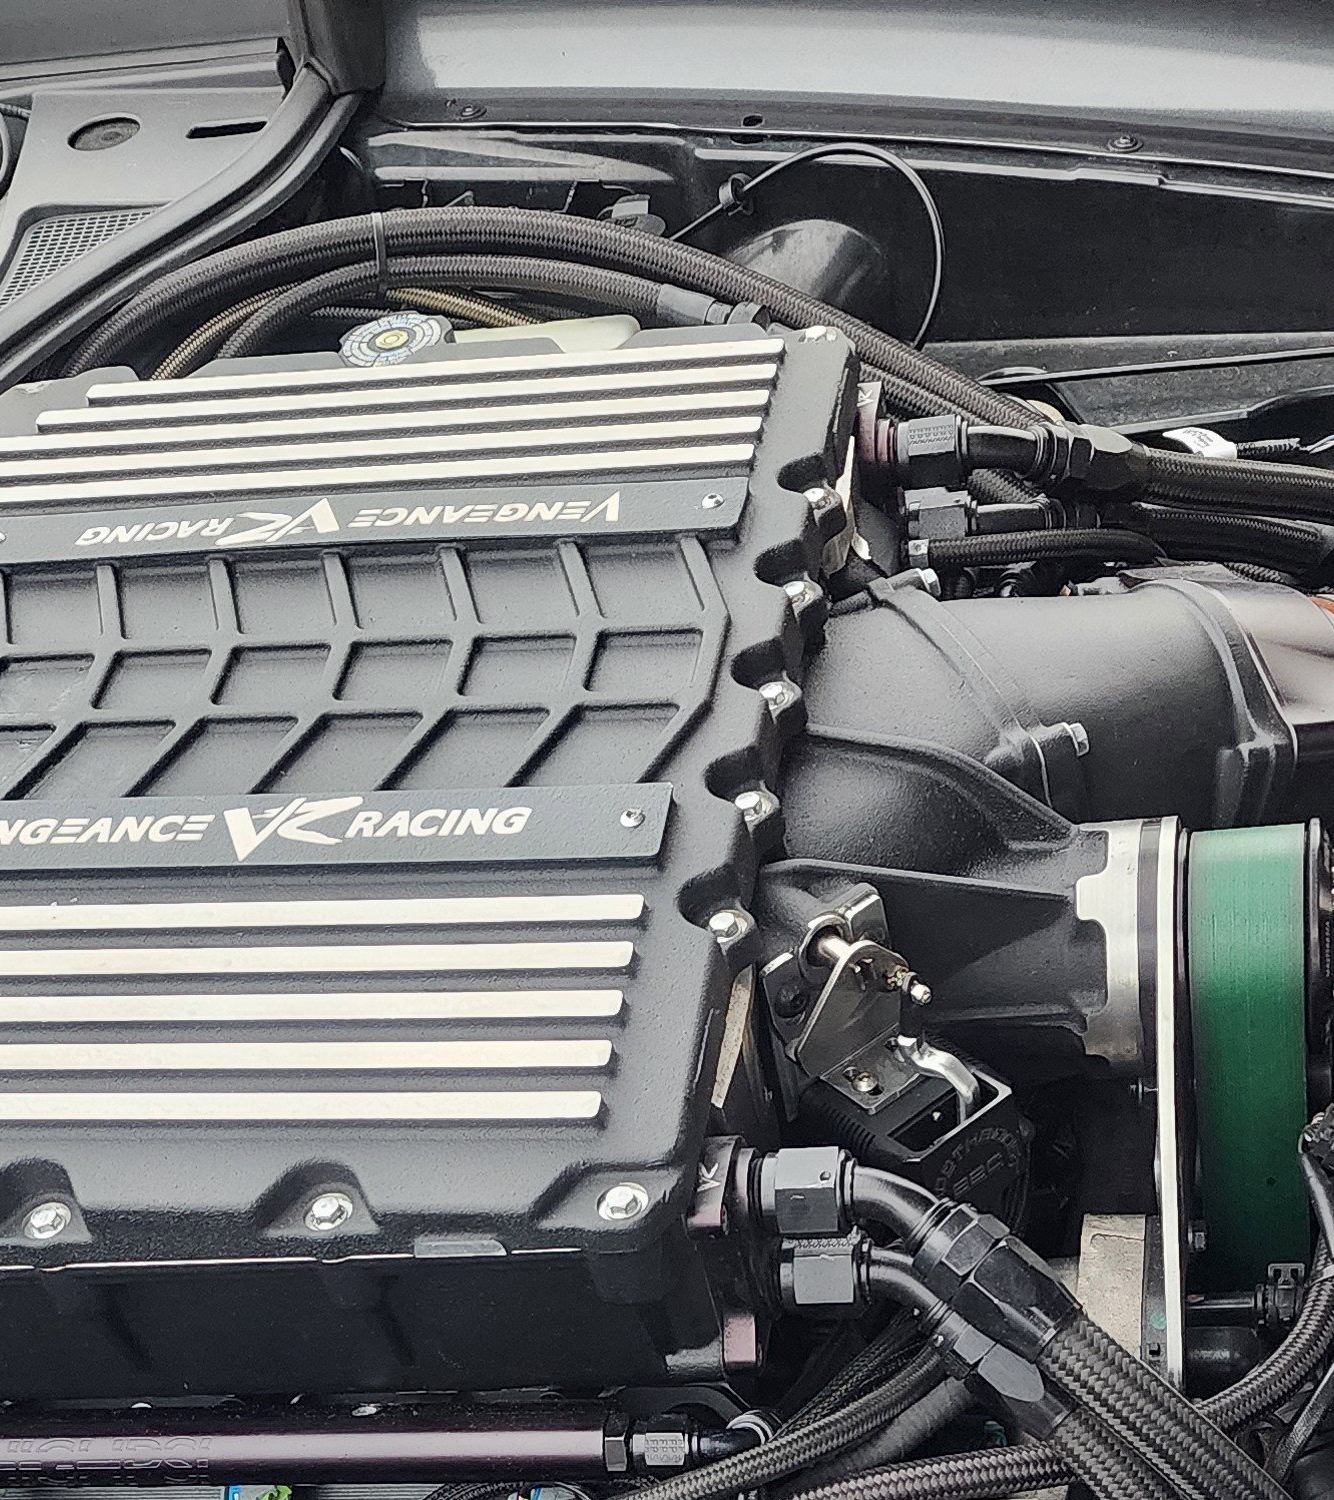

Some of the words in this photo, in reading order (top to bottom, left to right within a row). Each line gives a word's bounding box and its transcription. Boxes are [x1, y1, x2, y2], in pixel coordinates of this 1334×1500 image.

[348, 490, 621, 529] VENGEANCE
[73, 515, 235, 547] RACING
[343, 806, 534, 838] RACING
